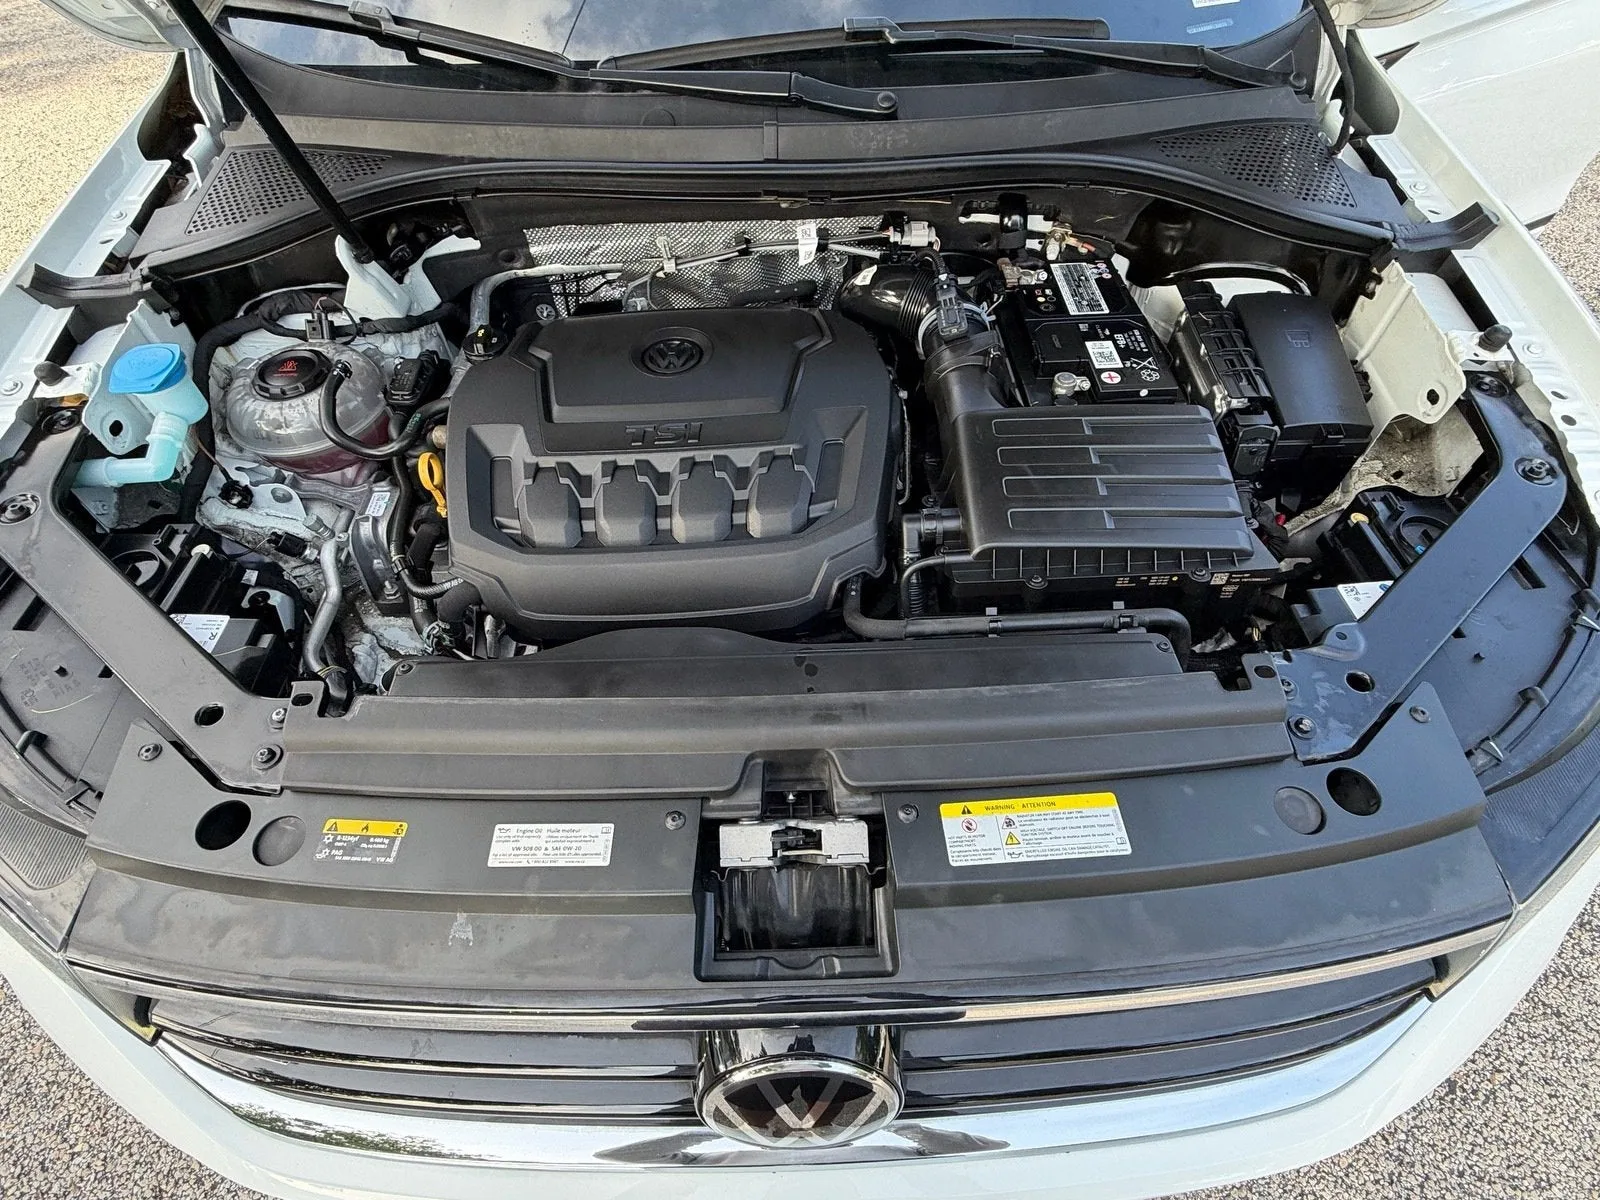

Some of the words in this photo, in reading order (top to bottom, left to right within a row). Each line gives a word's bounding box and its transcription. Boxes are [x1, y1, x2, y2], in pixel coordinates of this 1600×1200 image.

[625, 422, 704, 446] TSI
[984, 803, 1015, 811] WARNING
[1022, 801, 1056, 809] ATTENTION
